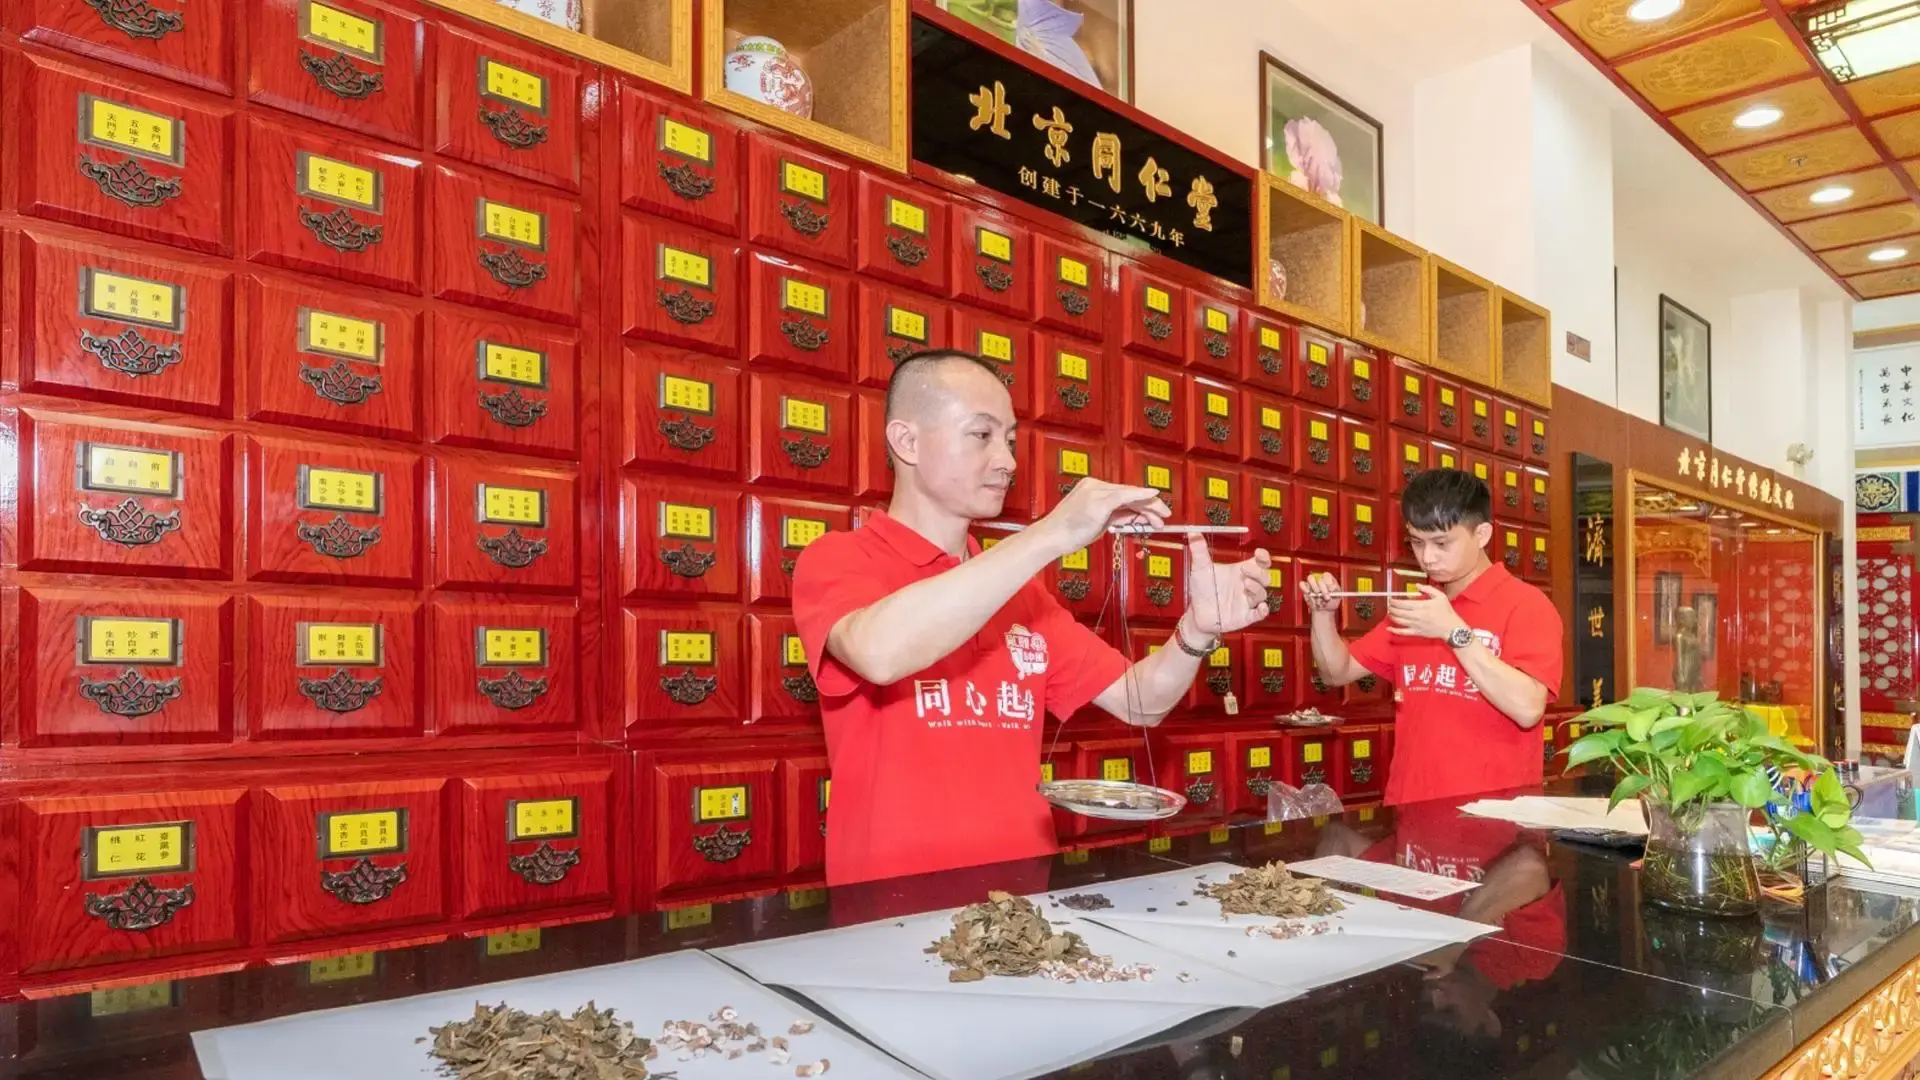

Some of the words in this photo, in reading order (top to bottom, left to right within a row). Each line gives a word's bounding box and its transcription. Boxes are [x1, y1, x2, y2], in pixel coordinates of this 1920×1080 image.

[129, 120, 140, 145] 五味子
[969, 80, 1218, 232] 北京同仁堂
[1017, 165, 1186, 248] 创建于一六六九年
[135, 834, 147, 862] 紅花
